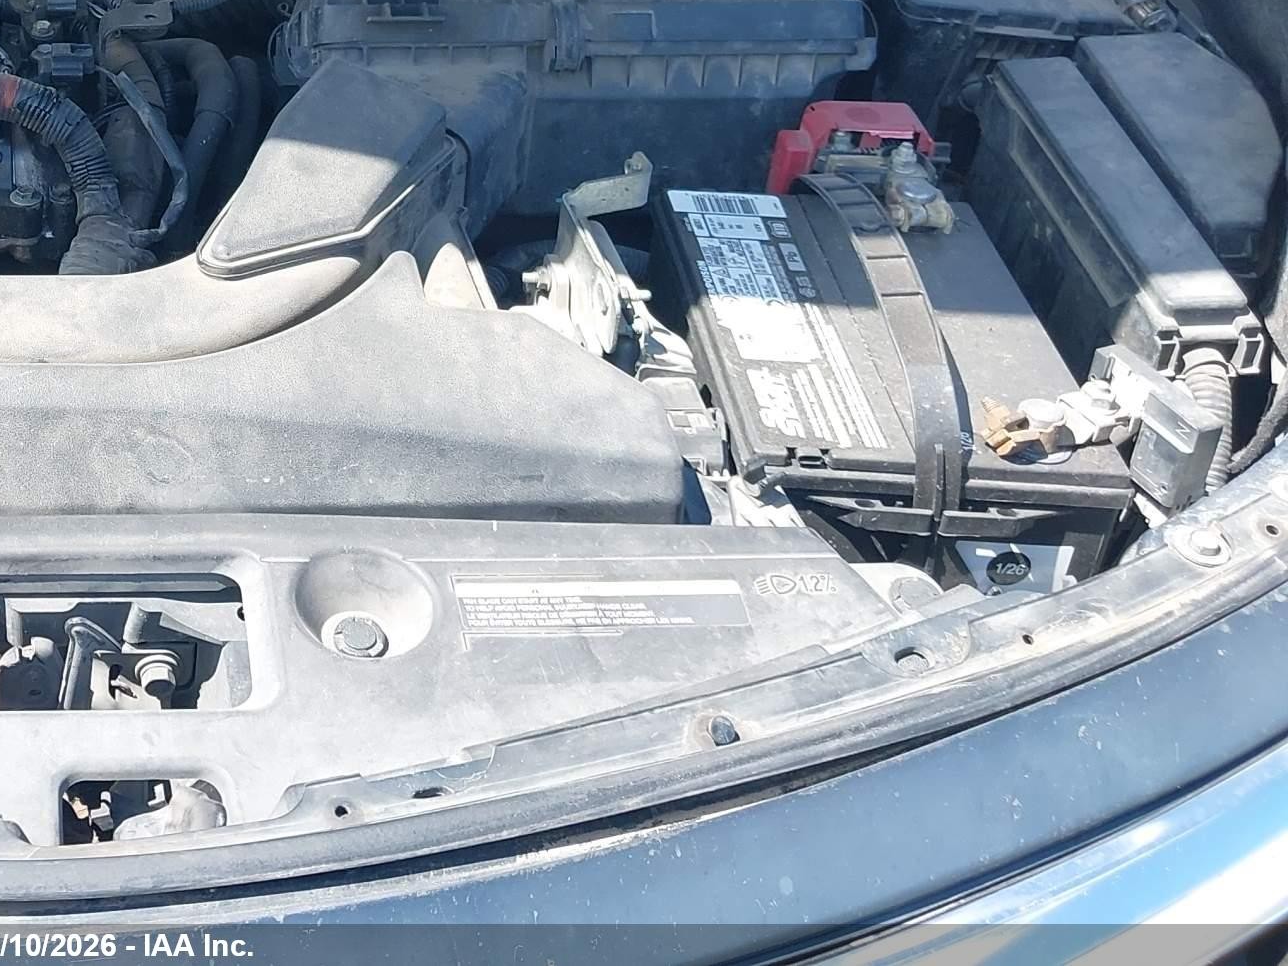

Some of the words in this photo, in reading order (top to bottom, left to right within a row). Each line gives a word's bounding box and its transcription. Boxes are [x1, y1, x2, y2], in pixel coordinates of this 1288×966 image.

[785, 251, 801, 263] Pb
[995, 562, 1029, 576] 1/26
[798, 573, 837, 593] 1.2%
